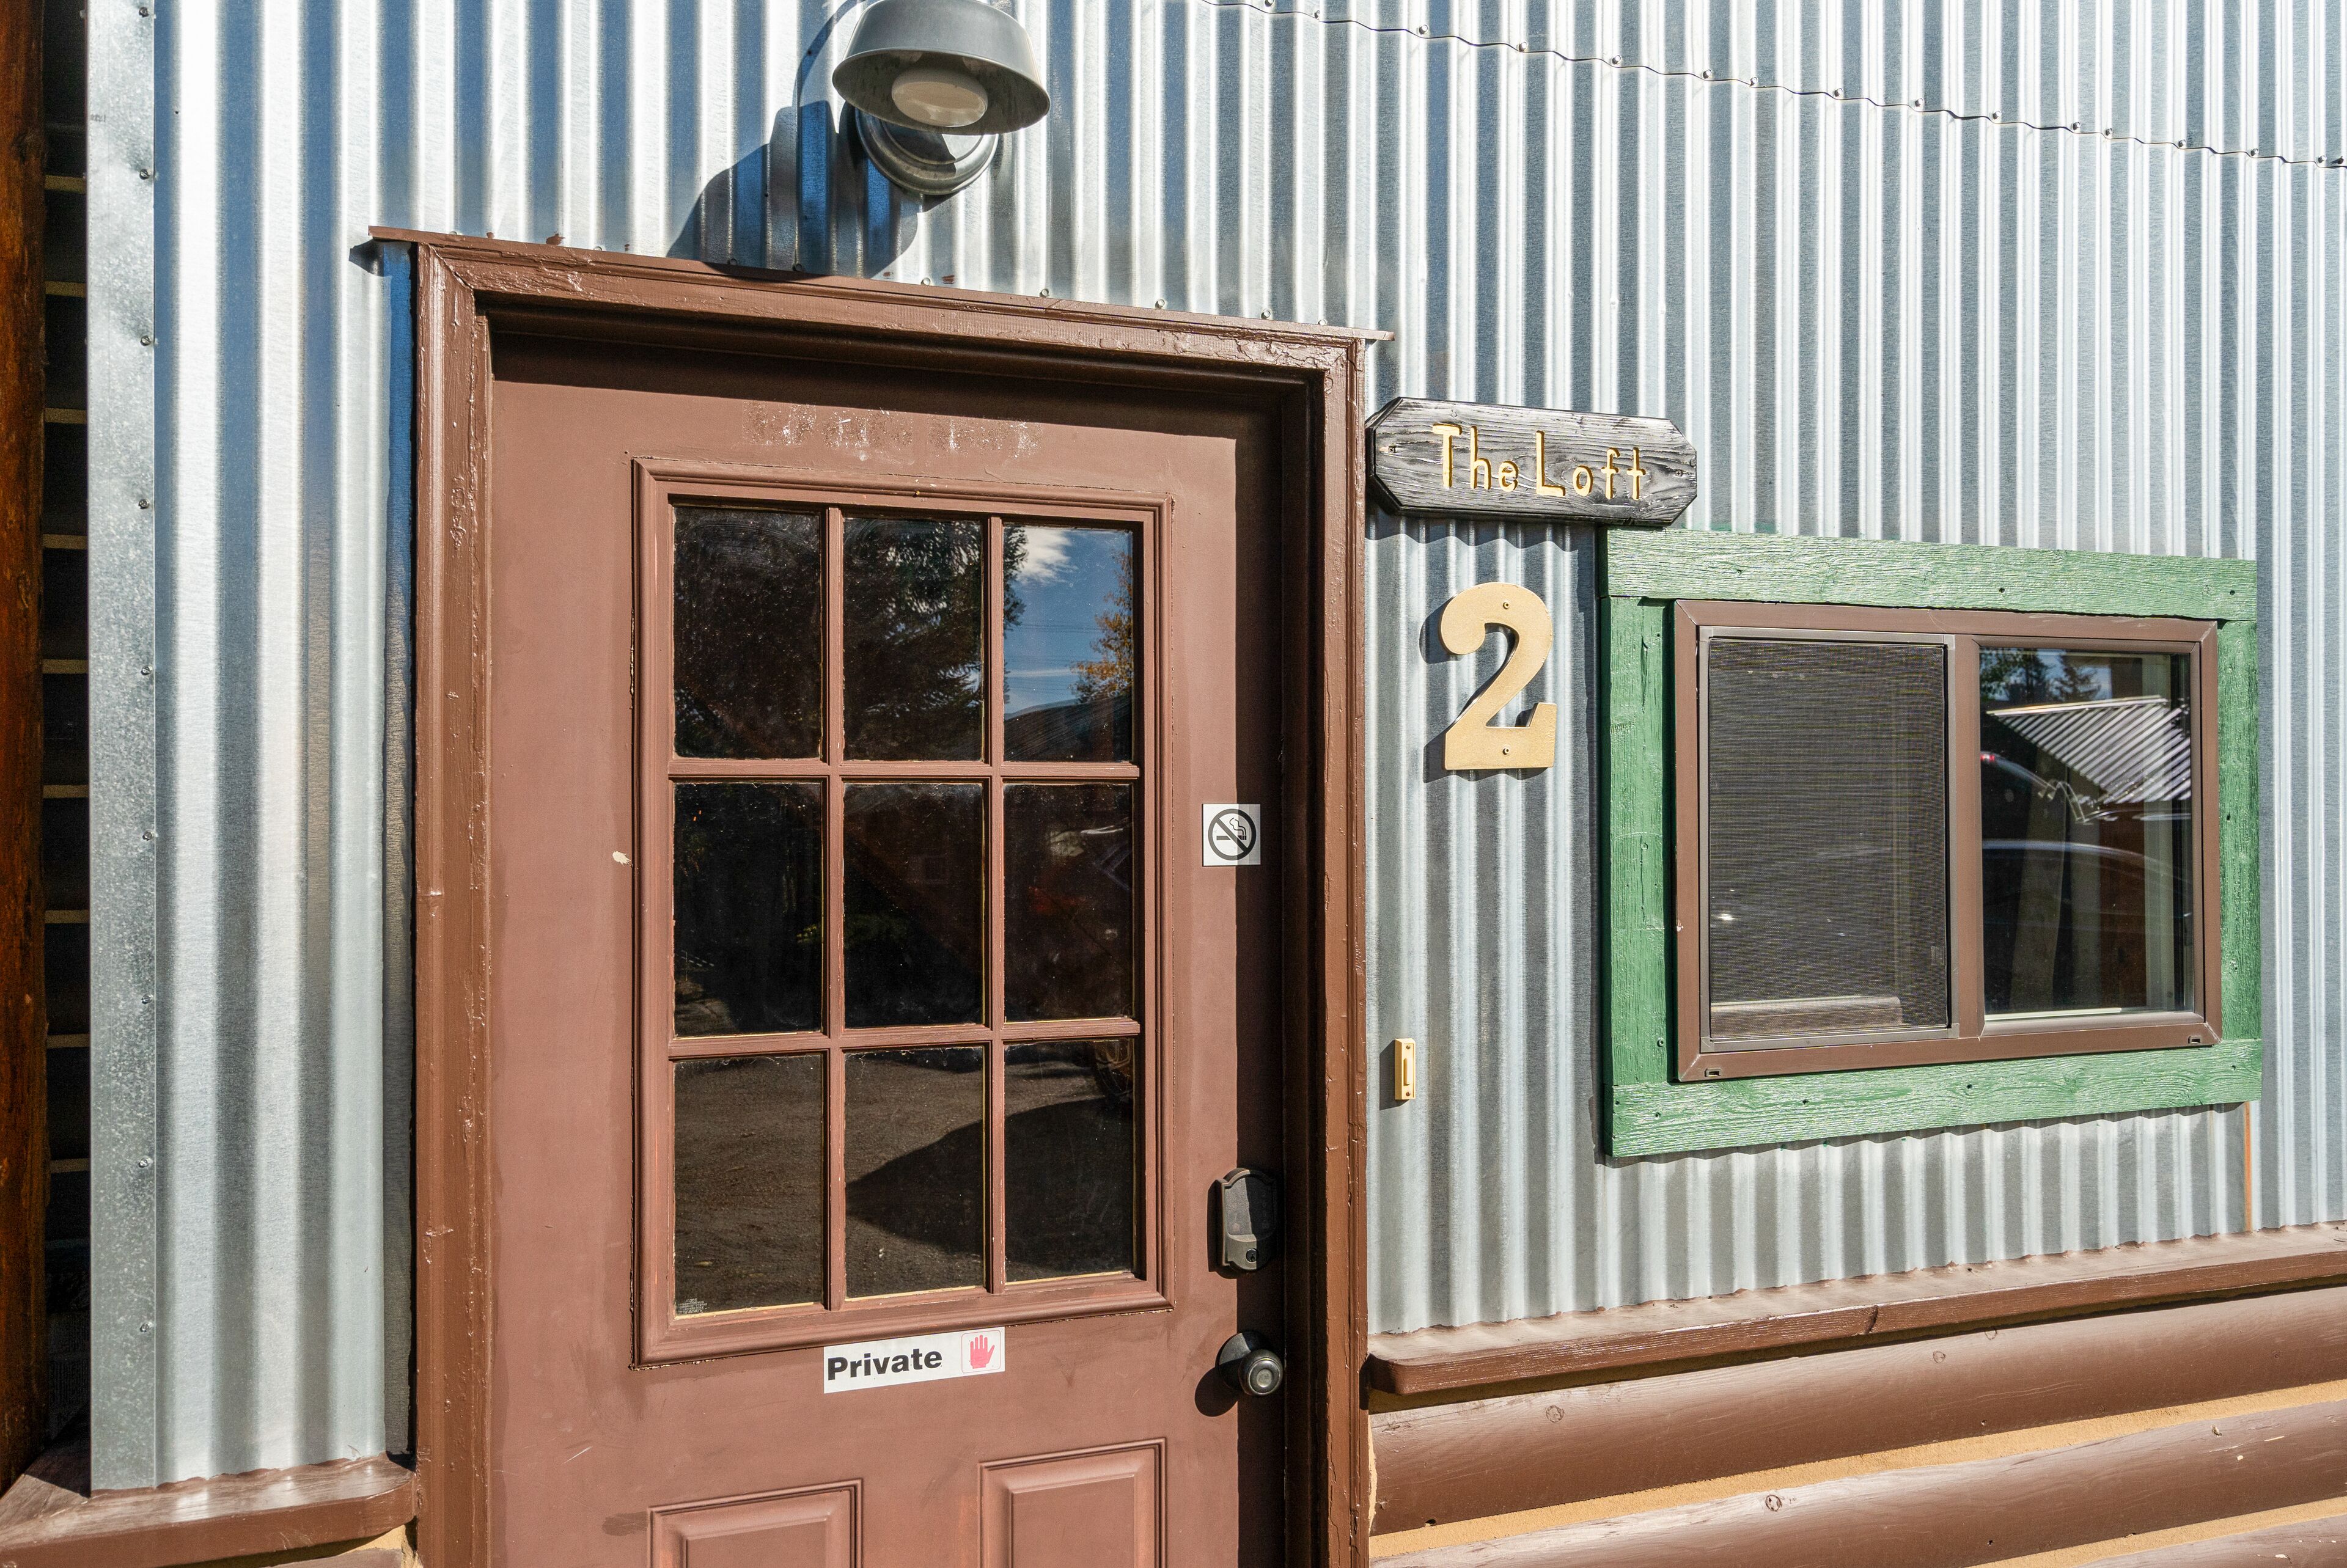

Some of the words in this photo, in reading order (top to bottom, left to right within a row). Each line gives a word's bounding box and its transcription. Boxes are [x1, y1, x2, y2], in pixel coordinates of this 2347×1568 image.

[1432, 422, 1519, 493] The
[1535, 430, 1647, 500] Loft
[1441, 582, 1557, 770] 2
[828, 1348, 942, 1380] Private
